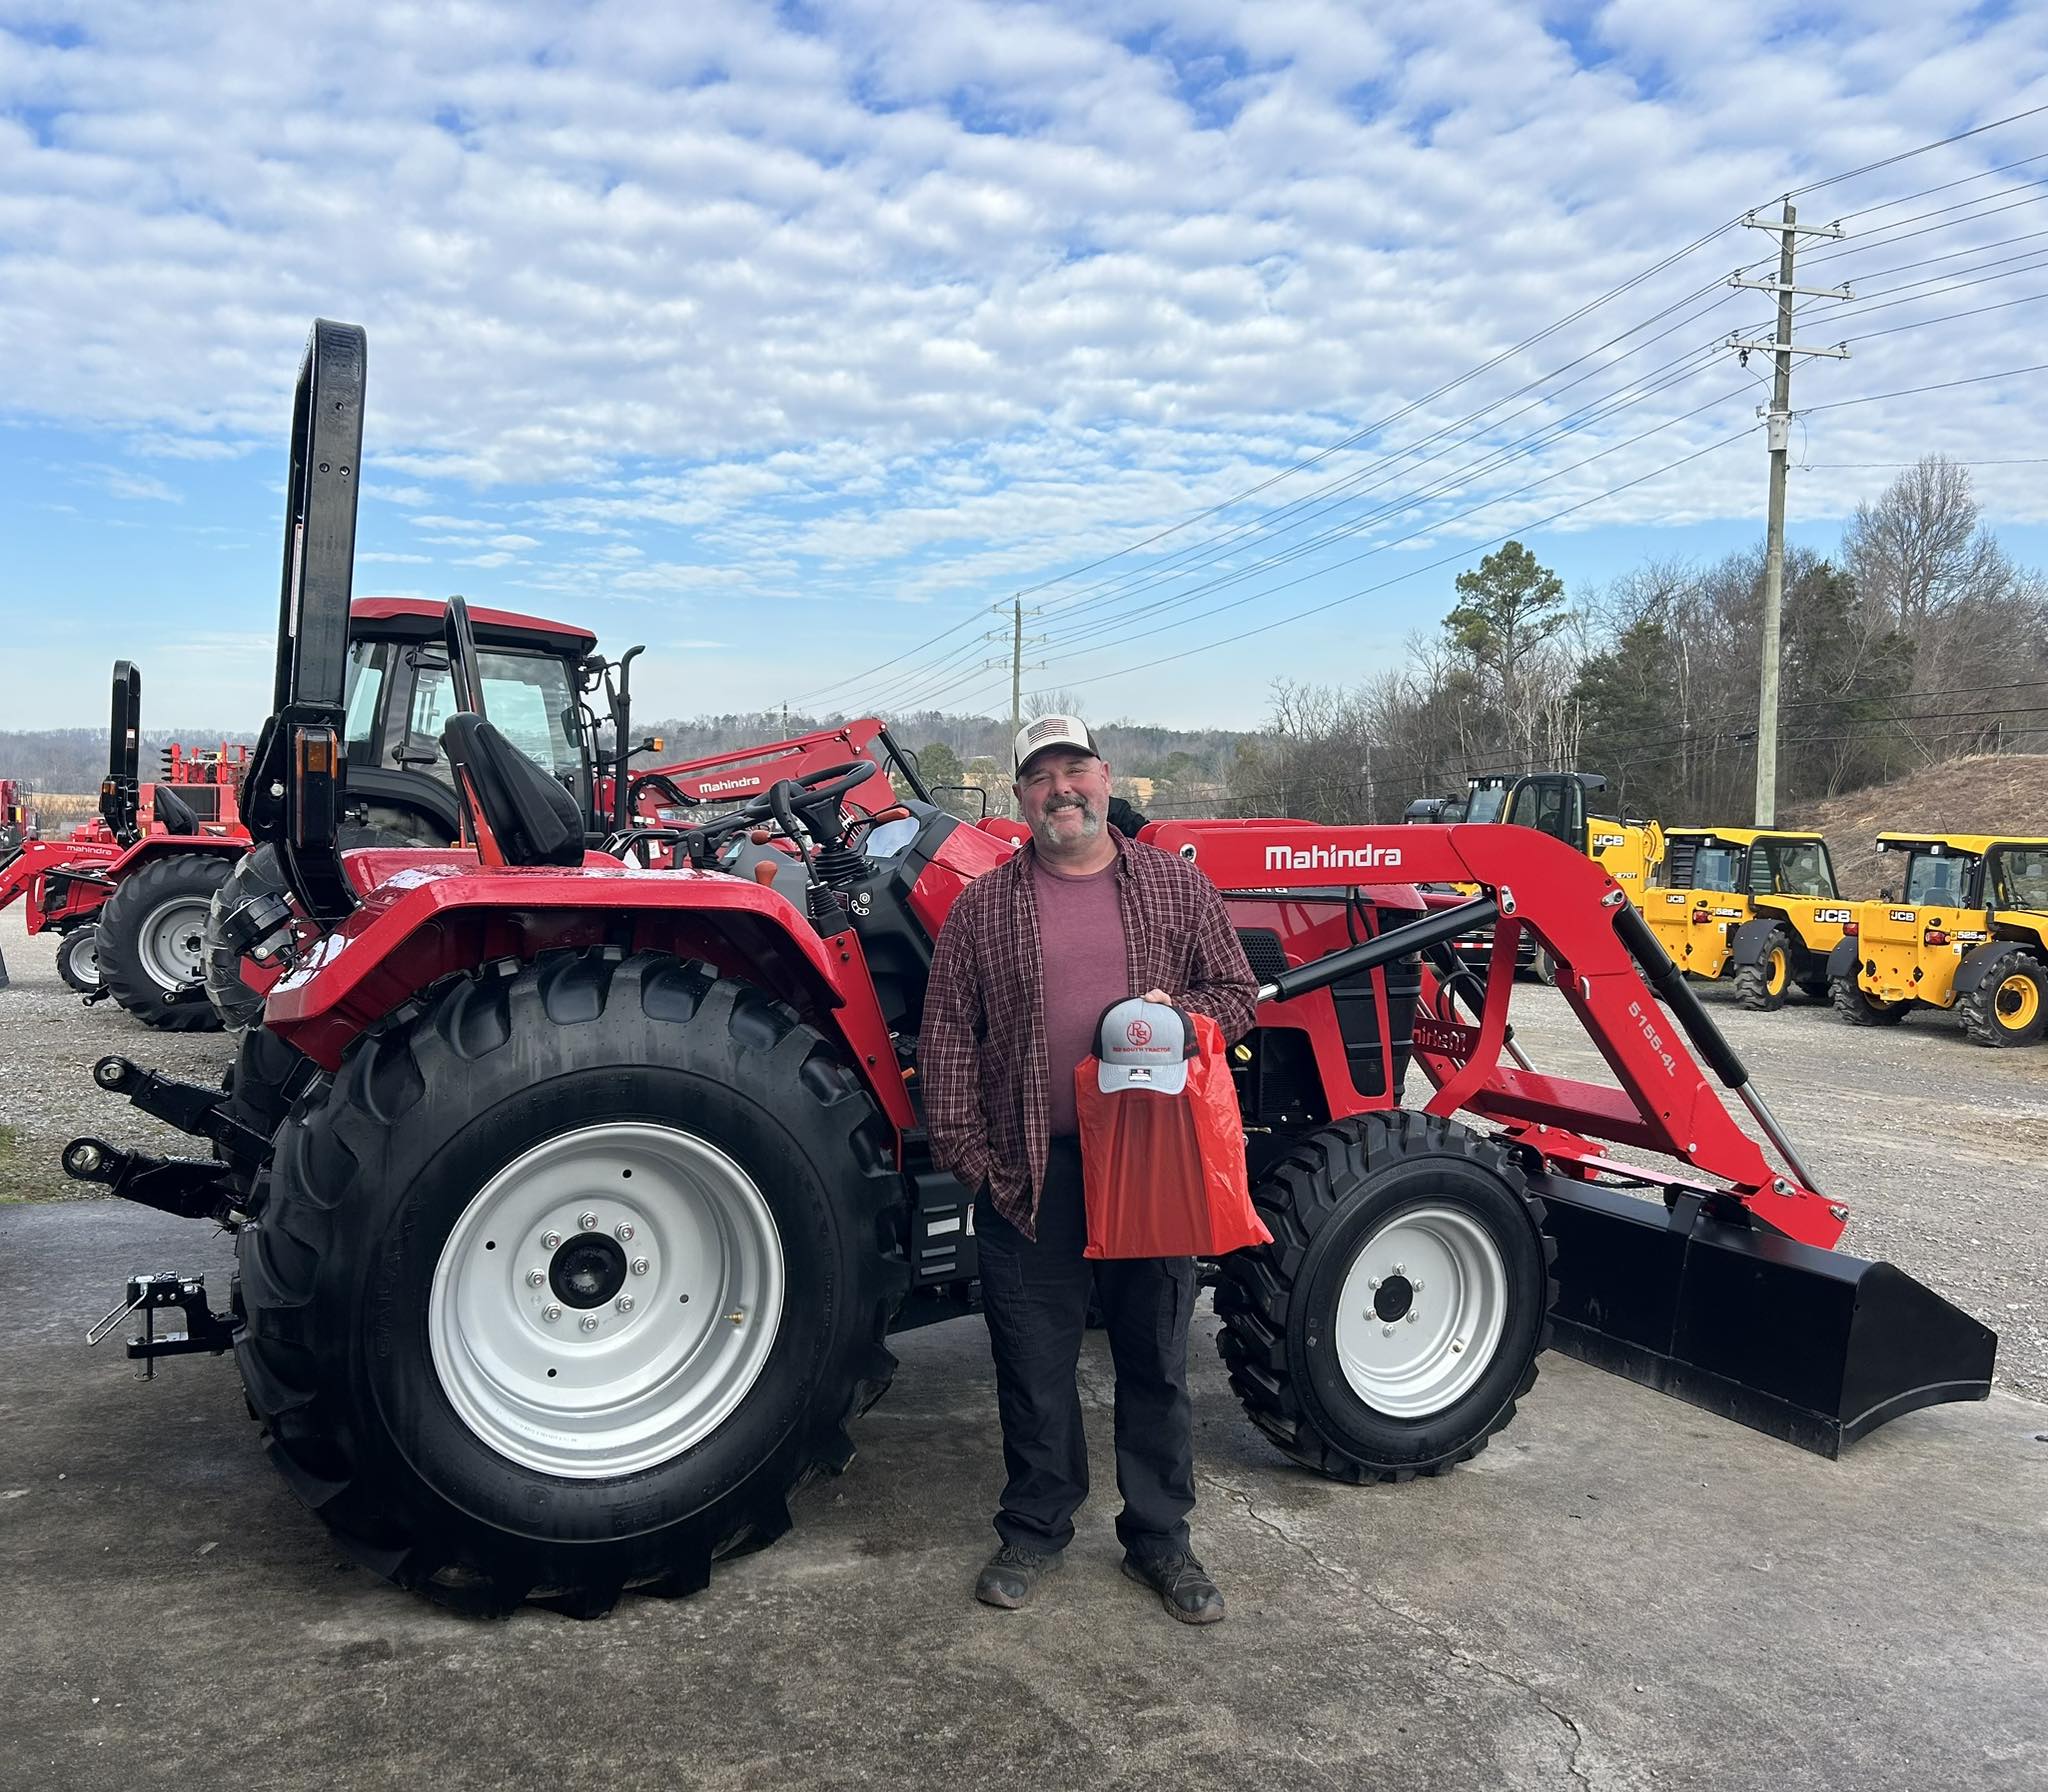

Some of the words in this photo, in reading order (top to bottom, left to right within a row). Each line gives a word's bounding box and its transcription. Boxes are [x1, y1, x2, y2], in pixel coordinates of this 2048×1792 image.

[699, 776, 760, 794] Mahindra
[1593, 834, 1624, 846] JCB
[66, 845, 112, 855] mahindra
[1265, 843, 1401, 870] Mahindra
[1667, 895, 1685, 904] JCB
[1814, 909, 1851, 922] JCB
[1890, 910, 1915, 922] JCB
[1628, 1001, 1676, 1077] 5155-4L
